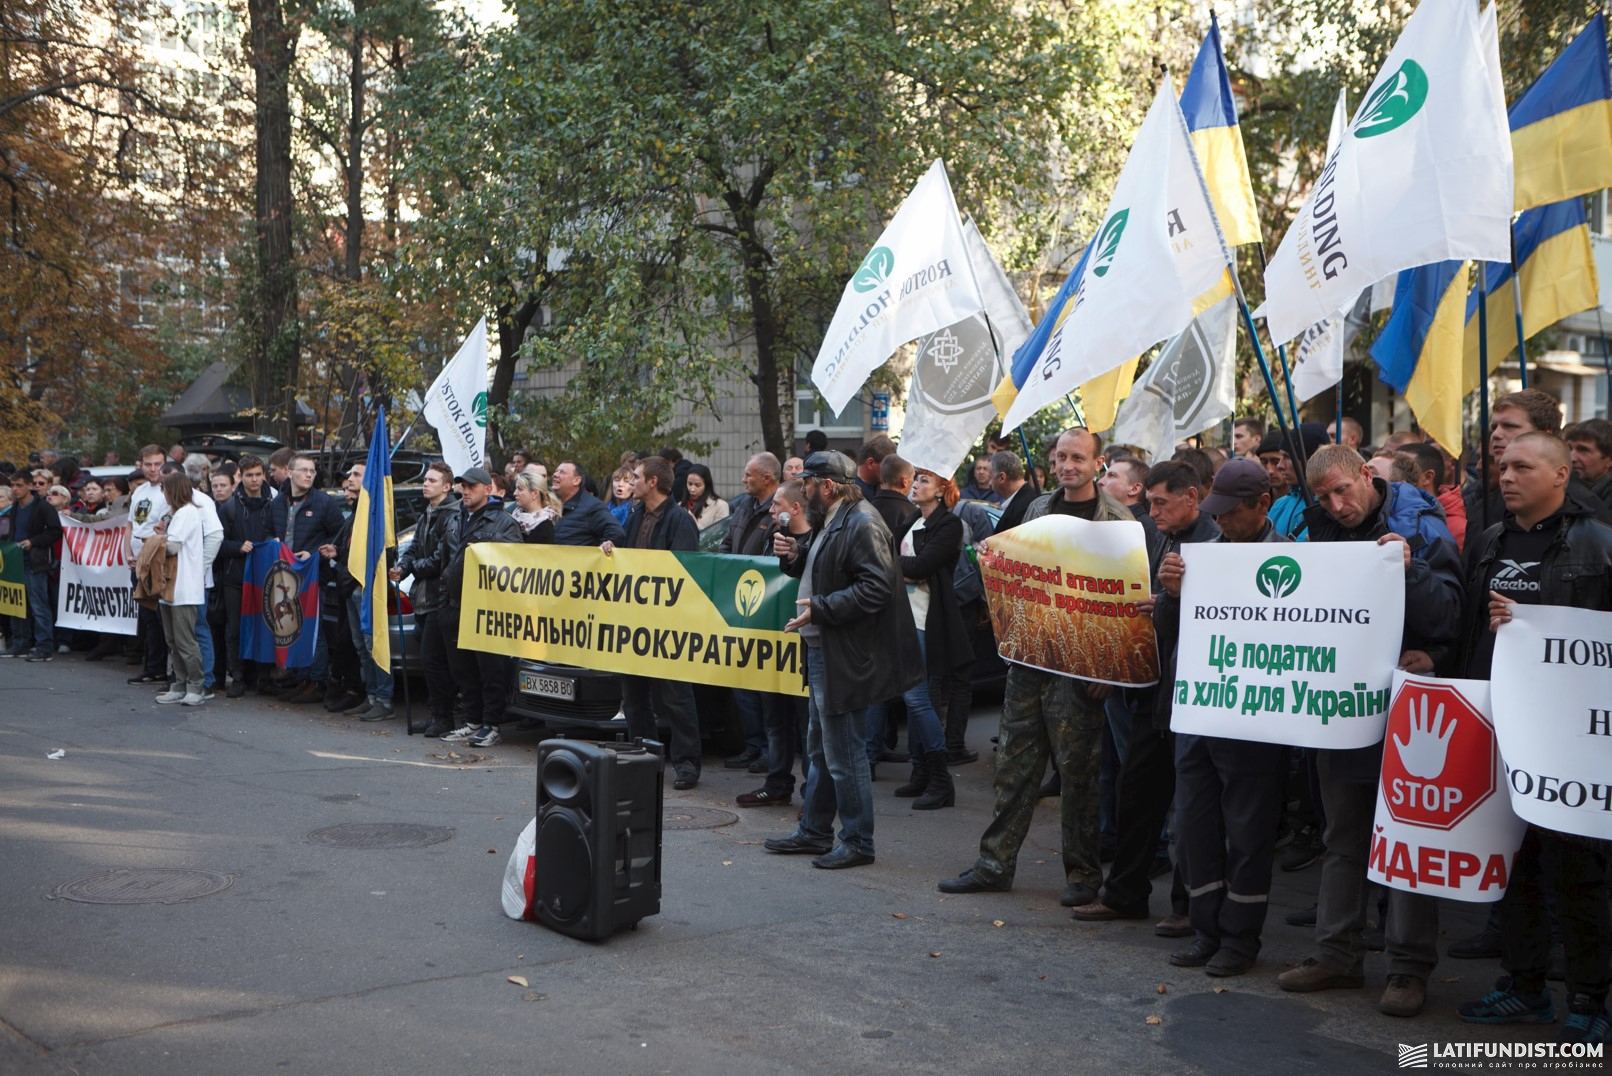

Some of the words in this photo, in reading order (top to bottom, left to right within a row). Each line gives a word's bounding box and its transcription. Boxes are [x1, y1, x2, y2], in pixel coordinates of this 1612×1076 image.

[459, 421, 484, 469] HOLDI
[0, 586, 23, 606] РИ!
[65, 579, 138, 620] РЕЙДЕРСТВА!
[478, 564, 564, 597] ПРОСИМО
[570, 570, 685, 607] ЗАХИСТУ
[985, 574, 1051, 606] загибель
[1055, 593, 1139, 619] врожаю
[1066, 573, 1124, 595] атаки
[1489, 578, 1541, 591] Reebo
[475, 608, 595, 649] ГЕНЕРАЛЬНОЇ
[1194, 605, 1268, 622] ROSTOK
[1272, 607, 1371, 625] HOLDING
[1208, 634, 1237, 673] Це
[1242, 643, 1336, 676] податки
[539, 678, 559, 693] 5858
[1192, 675, 1239, 709] хліб
[1241, 684, 1285, 716] для
[1391, 777, 1463, 813] STOP
[1503, 759, 1612, 812] ОБОЧ
[1369, 824, 1518, 891] ЙДЕРА
